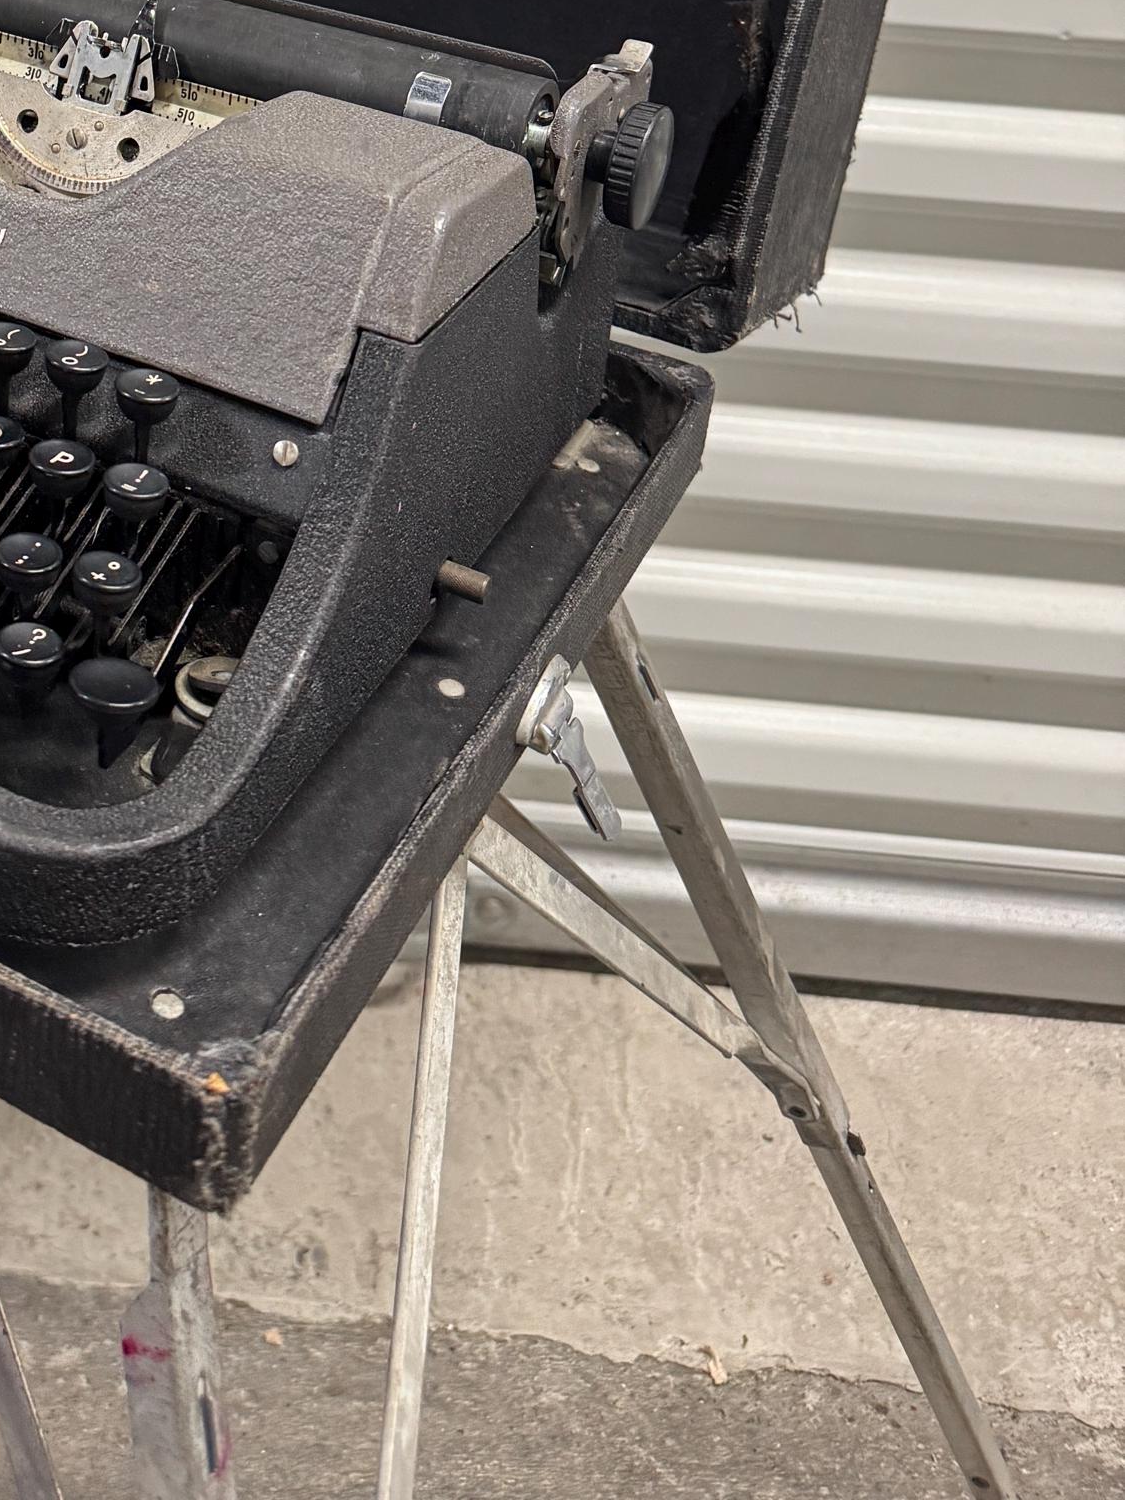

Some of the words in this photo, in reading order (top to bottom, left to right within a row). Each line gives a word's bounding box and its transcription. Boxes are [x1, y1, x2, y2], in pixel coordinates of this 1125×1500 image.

[24, 66, 42, 79] 30
[176, 107, 195, 122] 50
[27, 47, 44, 60] 30
[181, 89, 198, 102] 50
[49, 450, 75, 464] P
